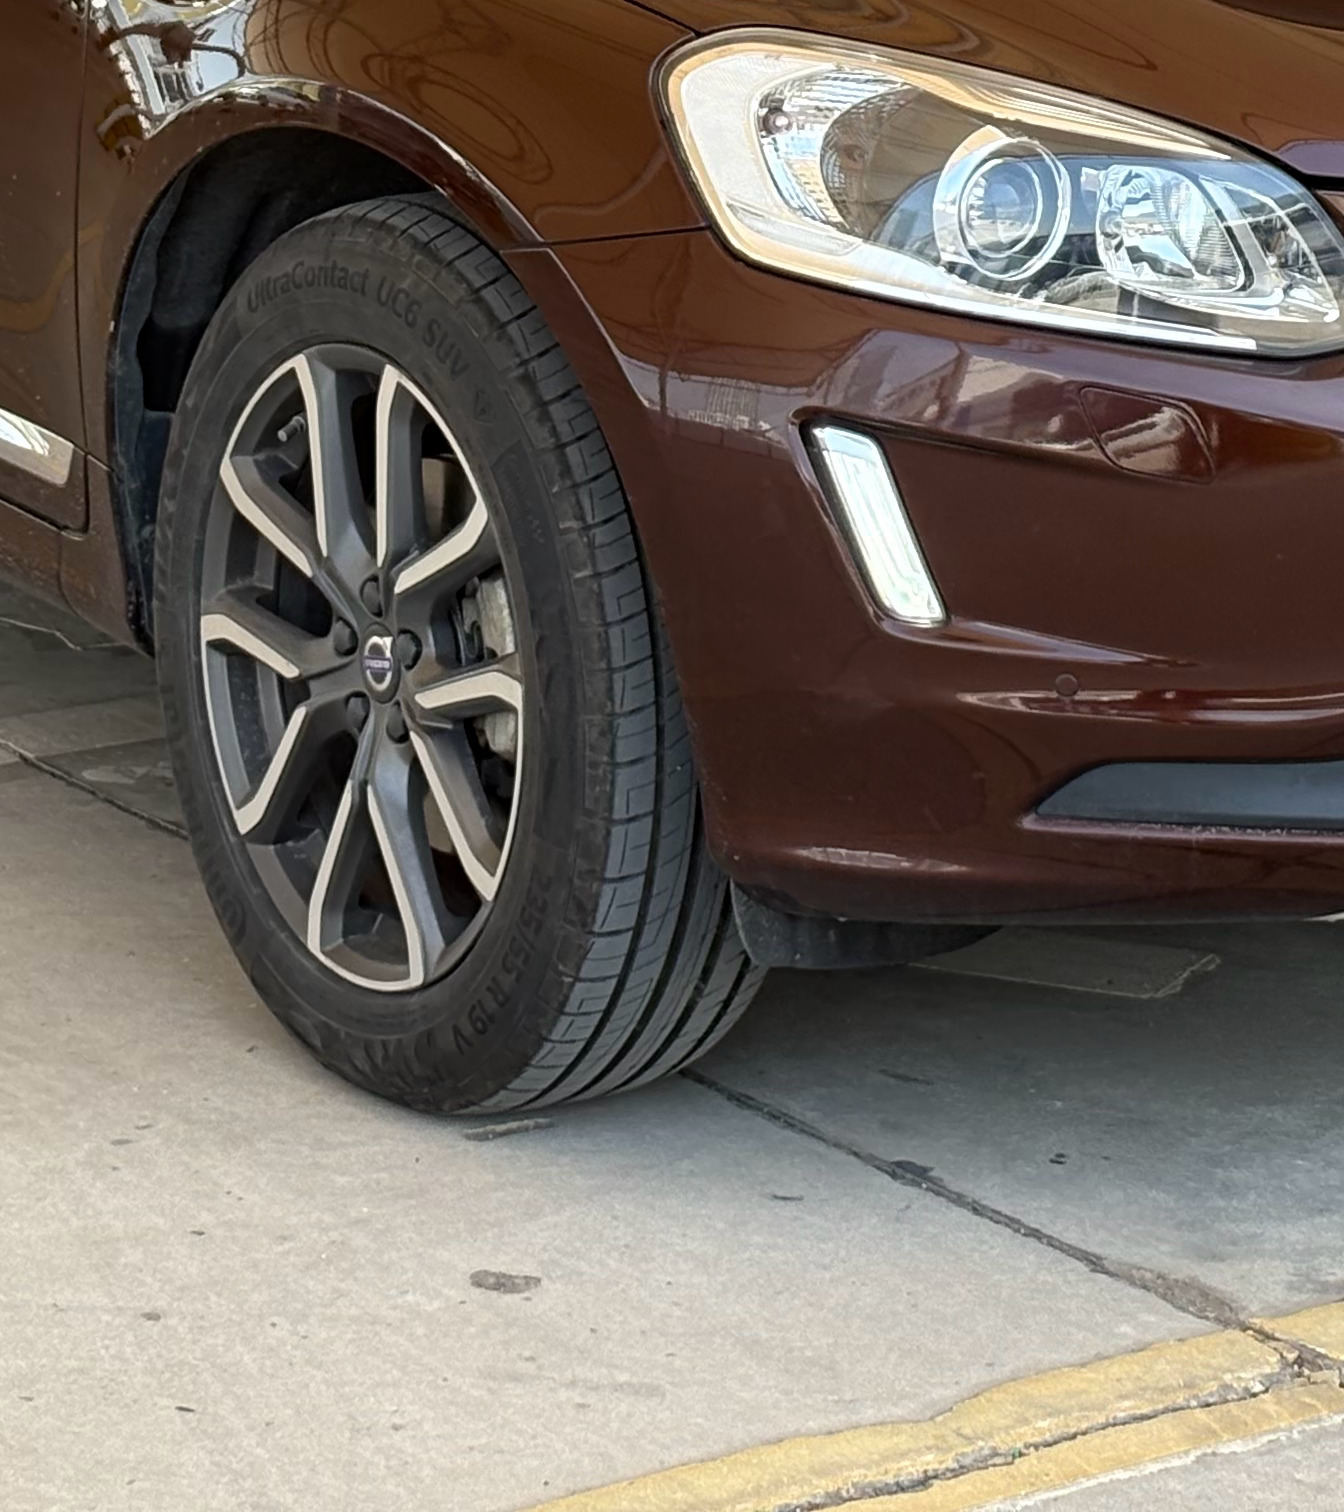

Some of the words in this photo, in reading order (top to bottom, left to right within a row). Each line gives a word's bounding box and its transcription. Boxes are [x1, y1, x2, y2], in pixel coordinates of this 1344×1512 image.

[247, 259, 370, 313] UltraContact
[376, 275, 423, 328] UC6
[423, 318, 471, 381] SUV
